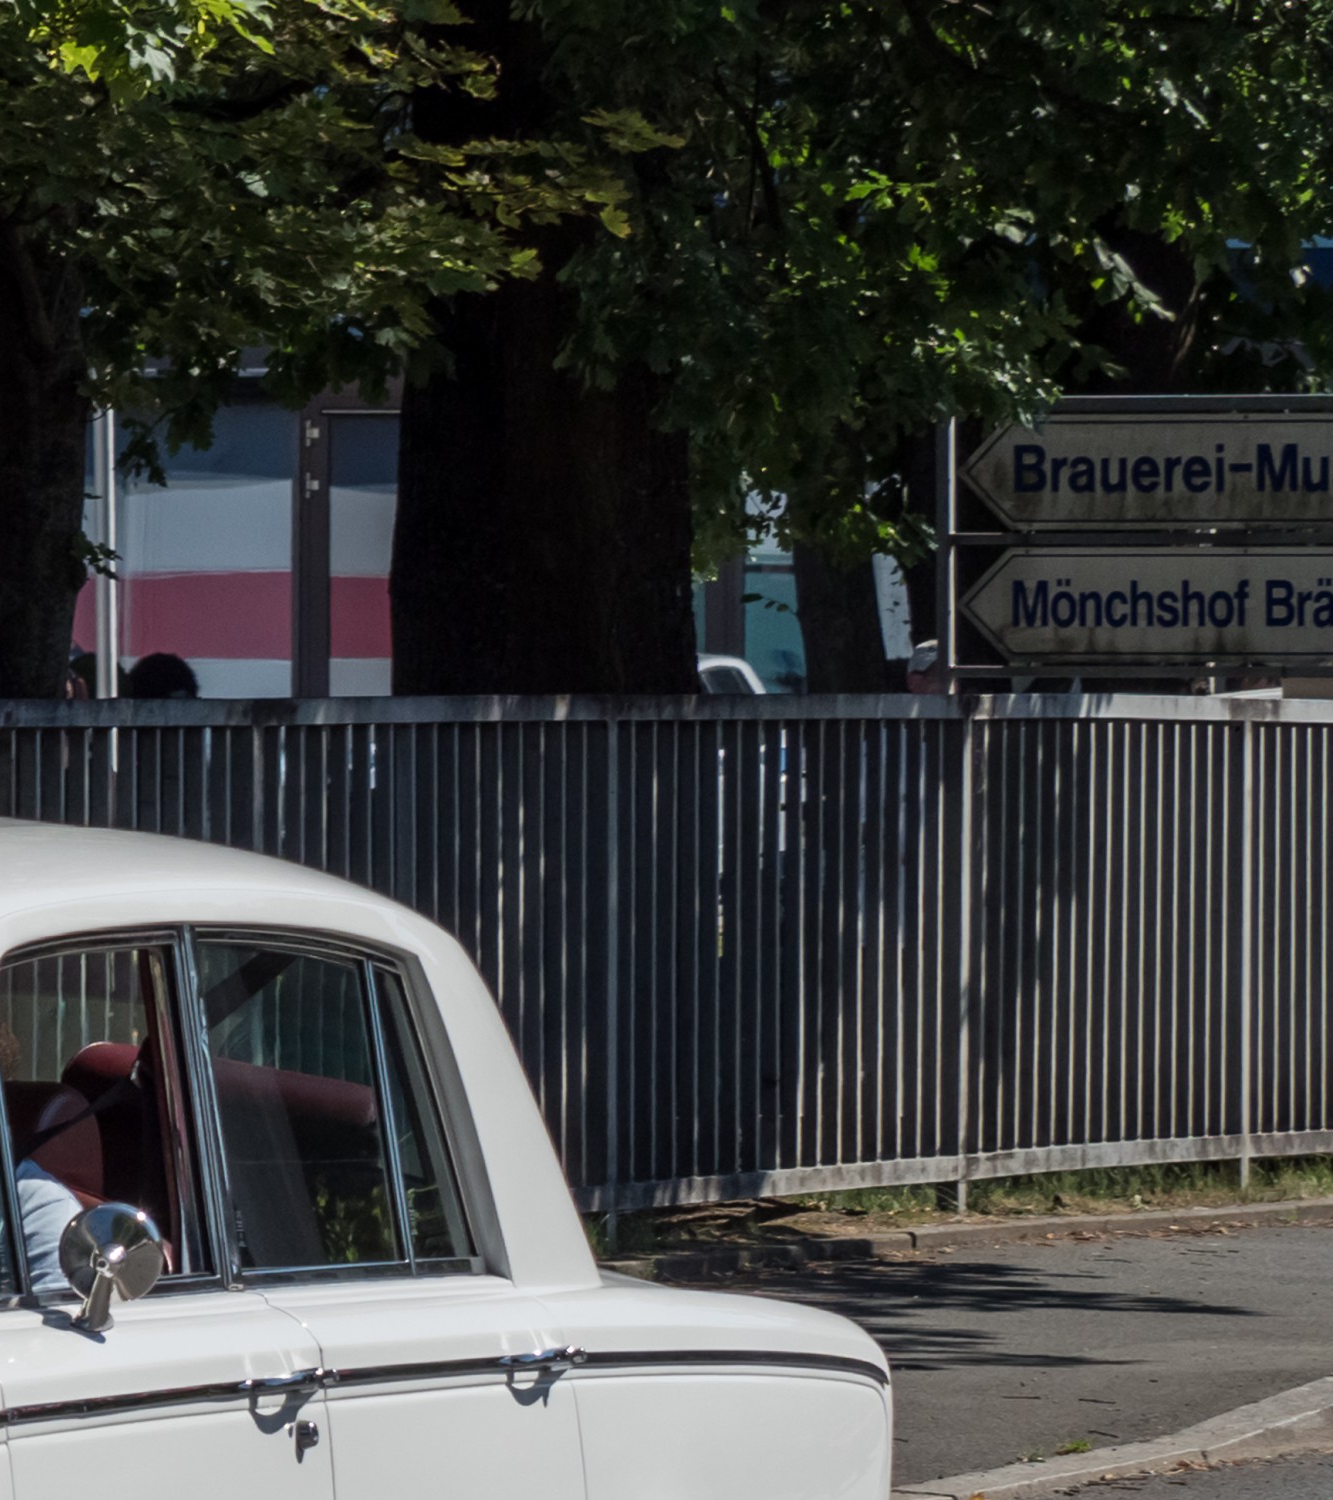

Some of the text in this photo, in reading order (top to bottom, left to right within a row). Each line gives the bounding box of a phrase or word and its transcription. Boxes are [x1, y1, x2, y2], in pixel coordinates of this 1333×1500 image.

[1013, 443, 1330, 493] Brauerei-Mu
[1012, 577, 1333, 629] Mönchshof Brä
